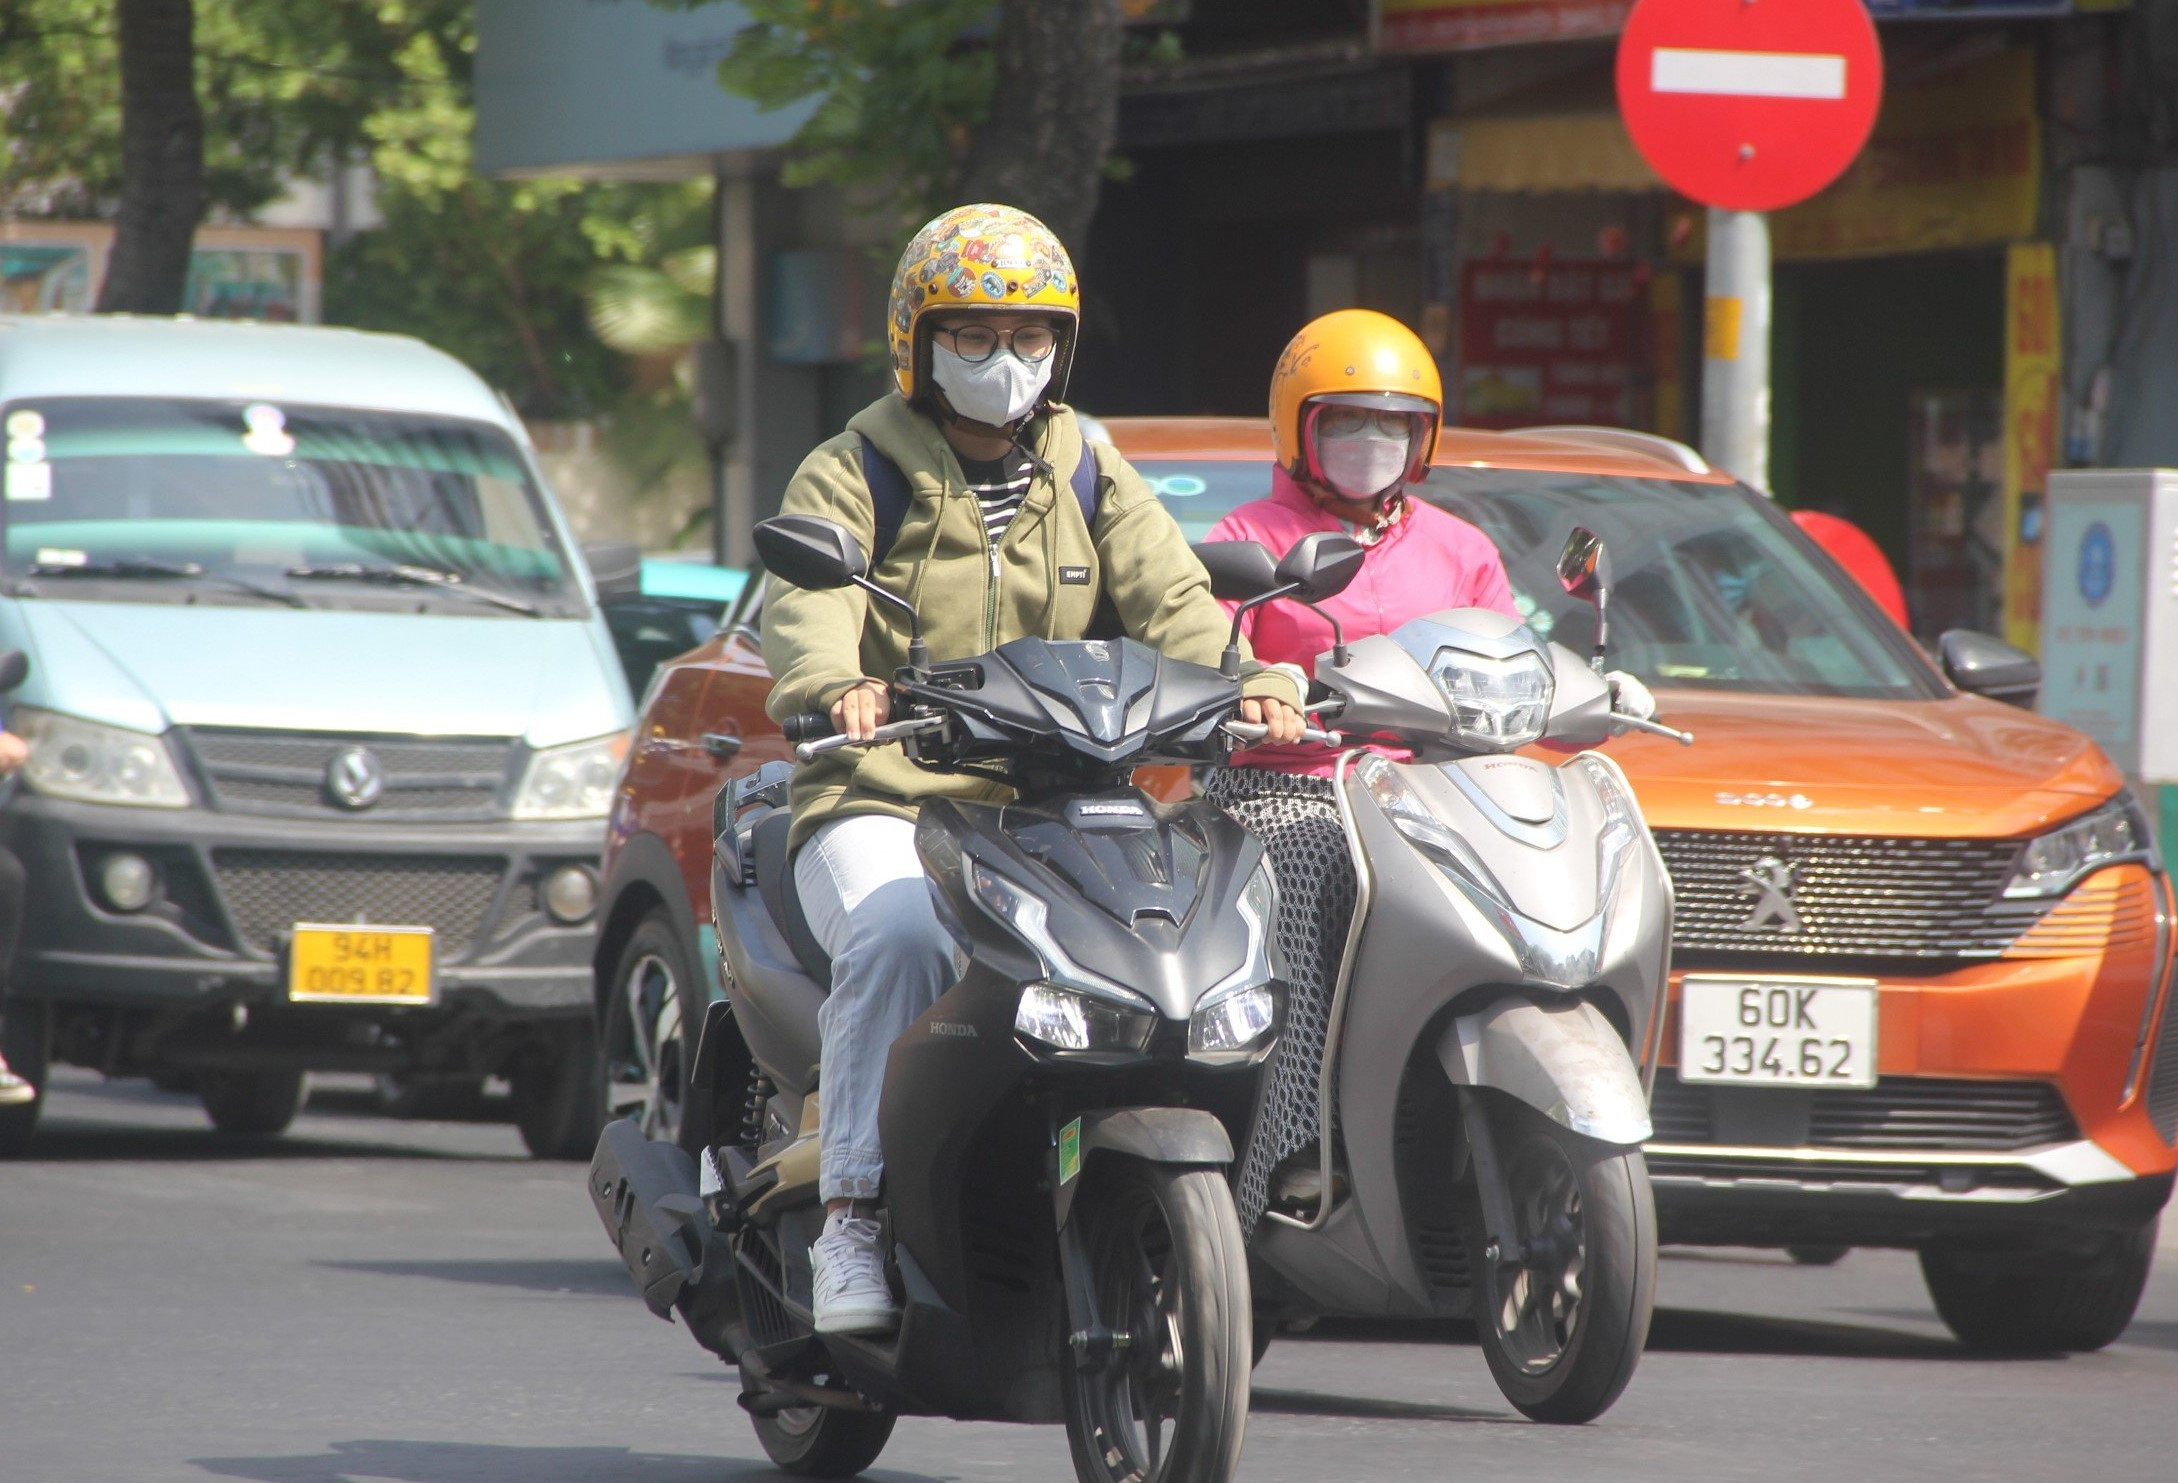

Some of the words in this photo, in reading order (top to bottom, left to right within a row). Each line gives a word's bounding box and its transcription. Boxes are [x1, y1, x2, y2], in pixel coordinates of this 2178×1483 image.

[1080, 805, 1143, 816] HONDA
[333, 933, 392, 962] 94H
[1740, 987, 1817, 1029] 60K
[929, 1021, 978, 1037] HONDA
[1702, 1034, 1852, 1078] 334.62
